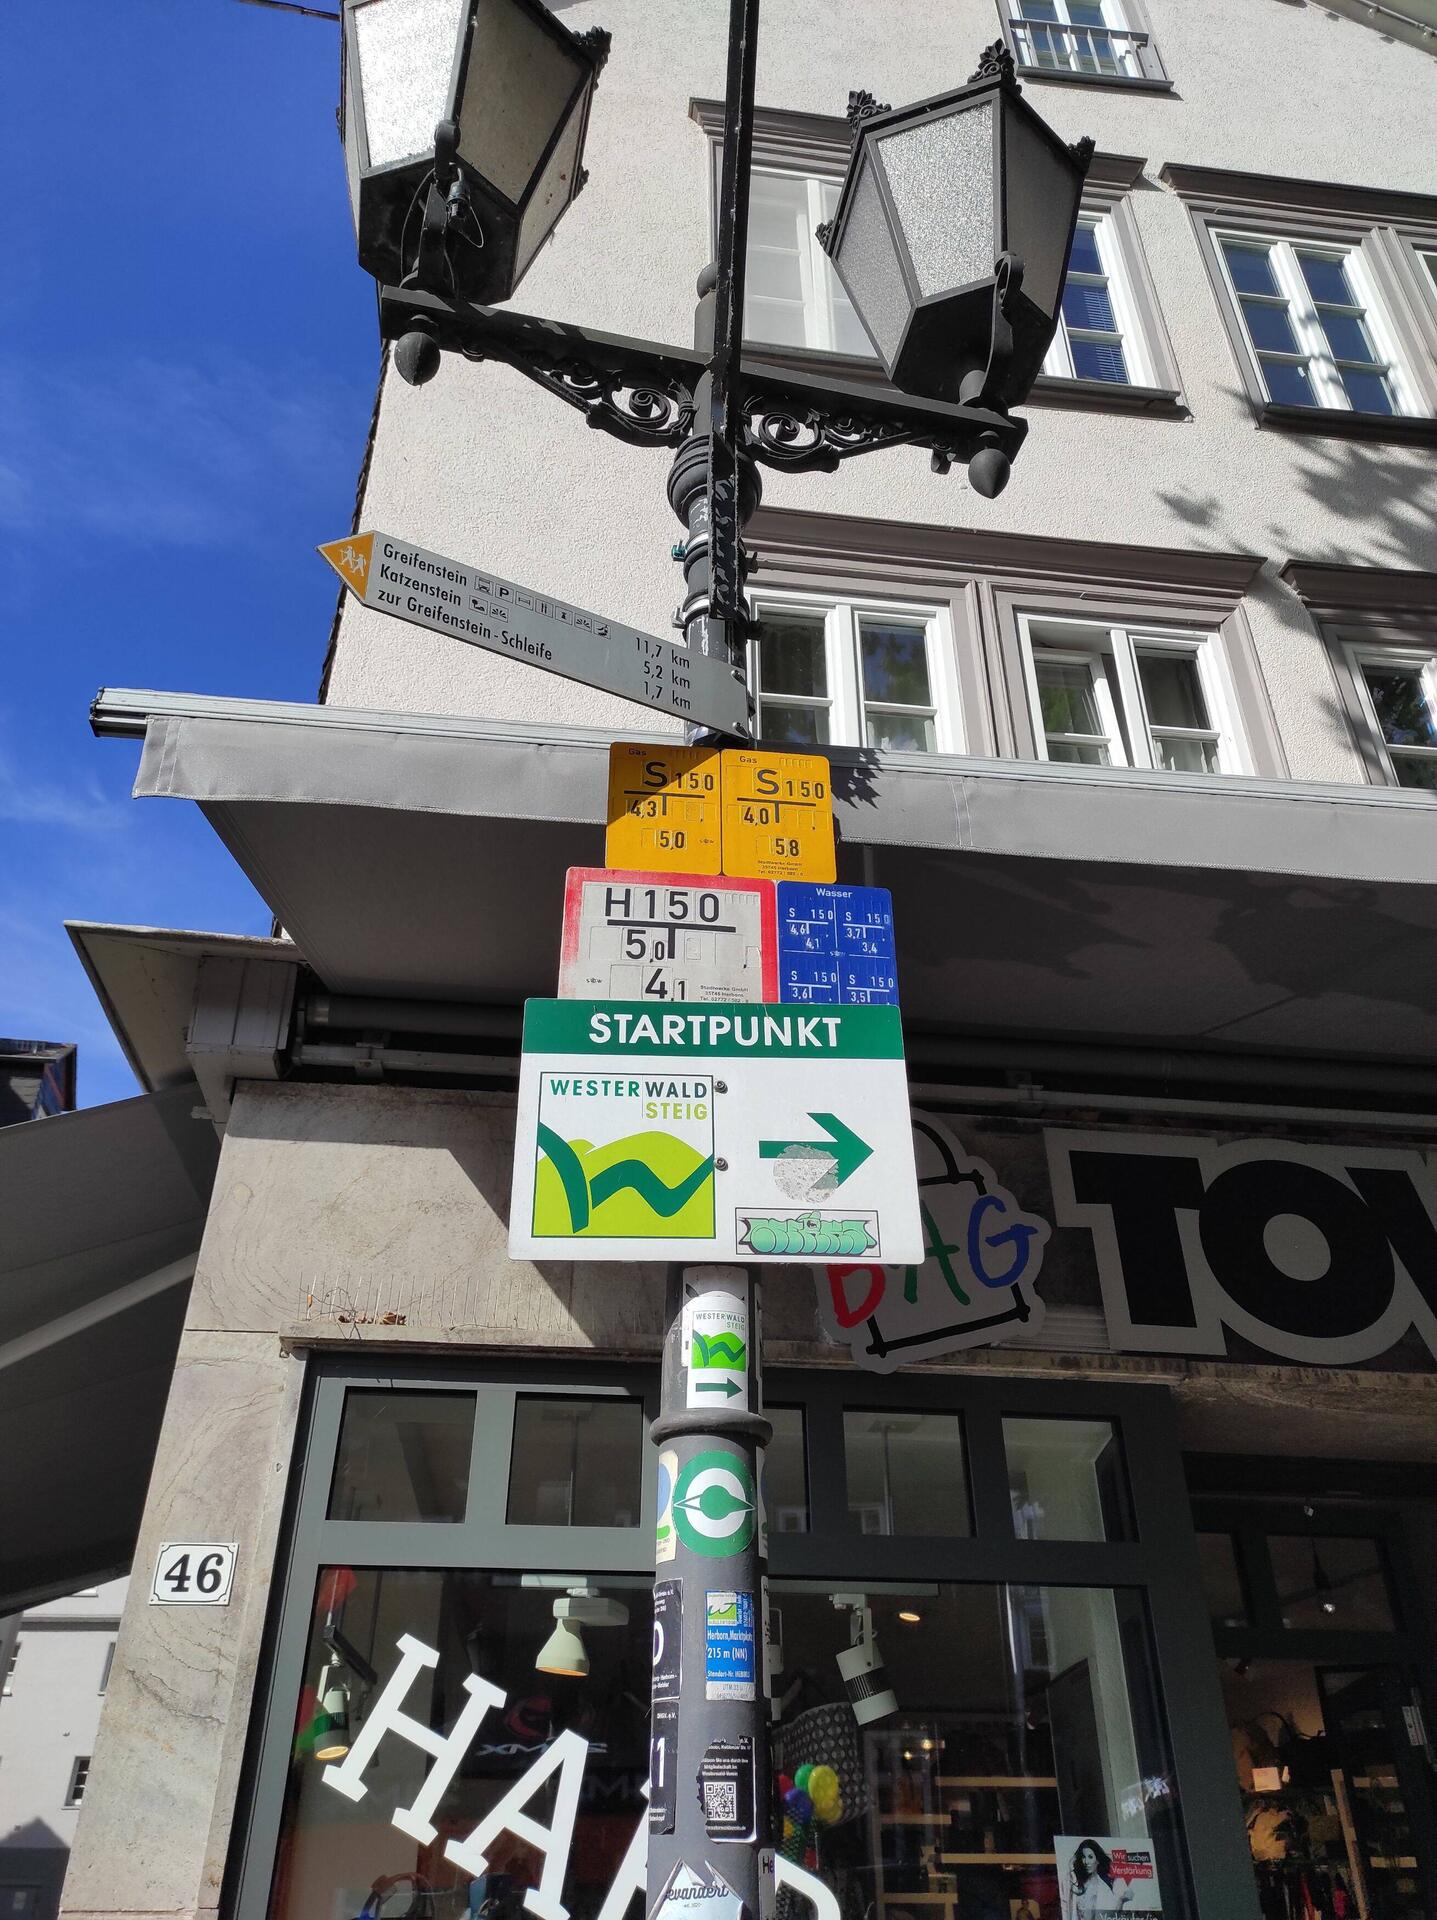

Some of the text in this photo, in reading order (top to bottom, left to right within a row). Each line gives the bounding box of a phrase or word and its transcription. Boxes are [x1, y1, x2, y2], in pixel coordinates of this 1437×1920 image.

[383, 543, 467, 586] Greifenstein
[636, 637, 662, 659] 11,7
[671, 649, 690, 669] km
[380, 564, 690, 689] Katzenstein 5,2 km
[377, 588, 402, 607] zur
[644, 681, 663, 700] 1,7
[672, 690, 691, 710] km
[628, 747, 647, 756] Gas
[739, 755, 758, 764] Gas
[644, 761, 714, 791] S 150
[756, 768, 825, 799] S 150
[630, 800, 657, 820] 4,3
[743, 806, 769, 826] 4,0
[660, 831, 685, 850] 5,0
[775, 838, 800, 858] 5,8
[816, 888, 853, 898] Wasser
[788, 907, 834, 920] S 150
[845, 911, 852, 921] S
[791, 970, 837, 983] S 150
[849, 974, 894, 988] S 150
[588, 1012, 841, 1048] STARTPUNKT
[645, 1102, 708, 1121] STEIG
[726, 1321, 745, 1330] STEIG
[164, 1552, 225, 1595] 46
[707, 1647, 721, 1659] 215
[723, 1650, 731, 1659] m
[1113, 1852, 1150, 1862] Wir suchen
